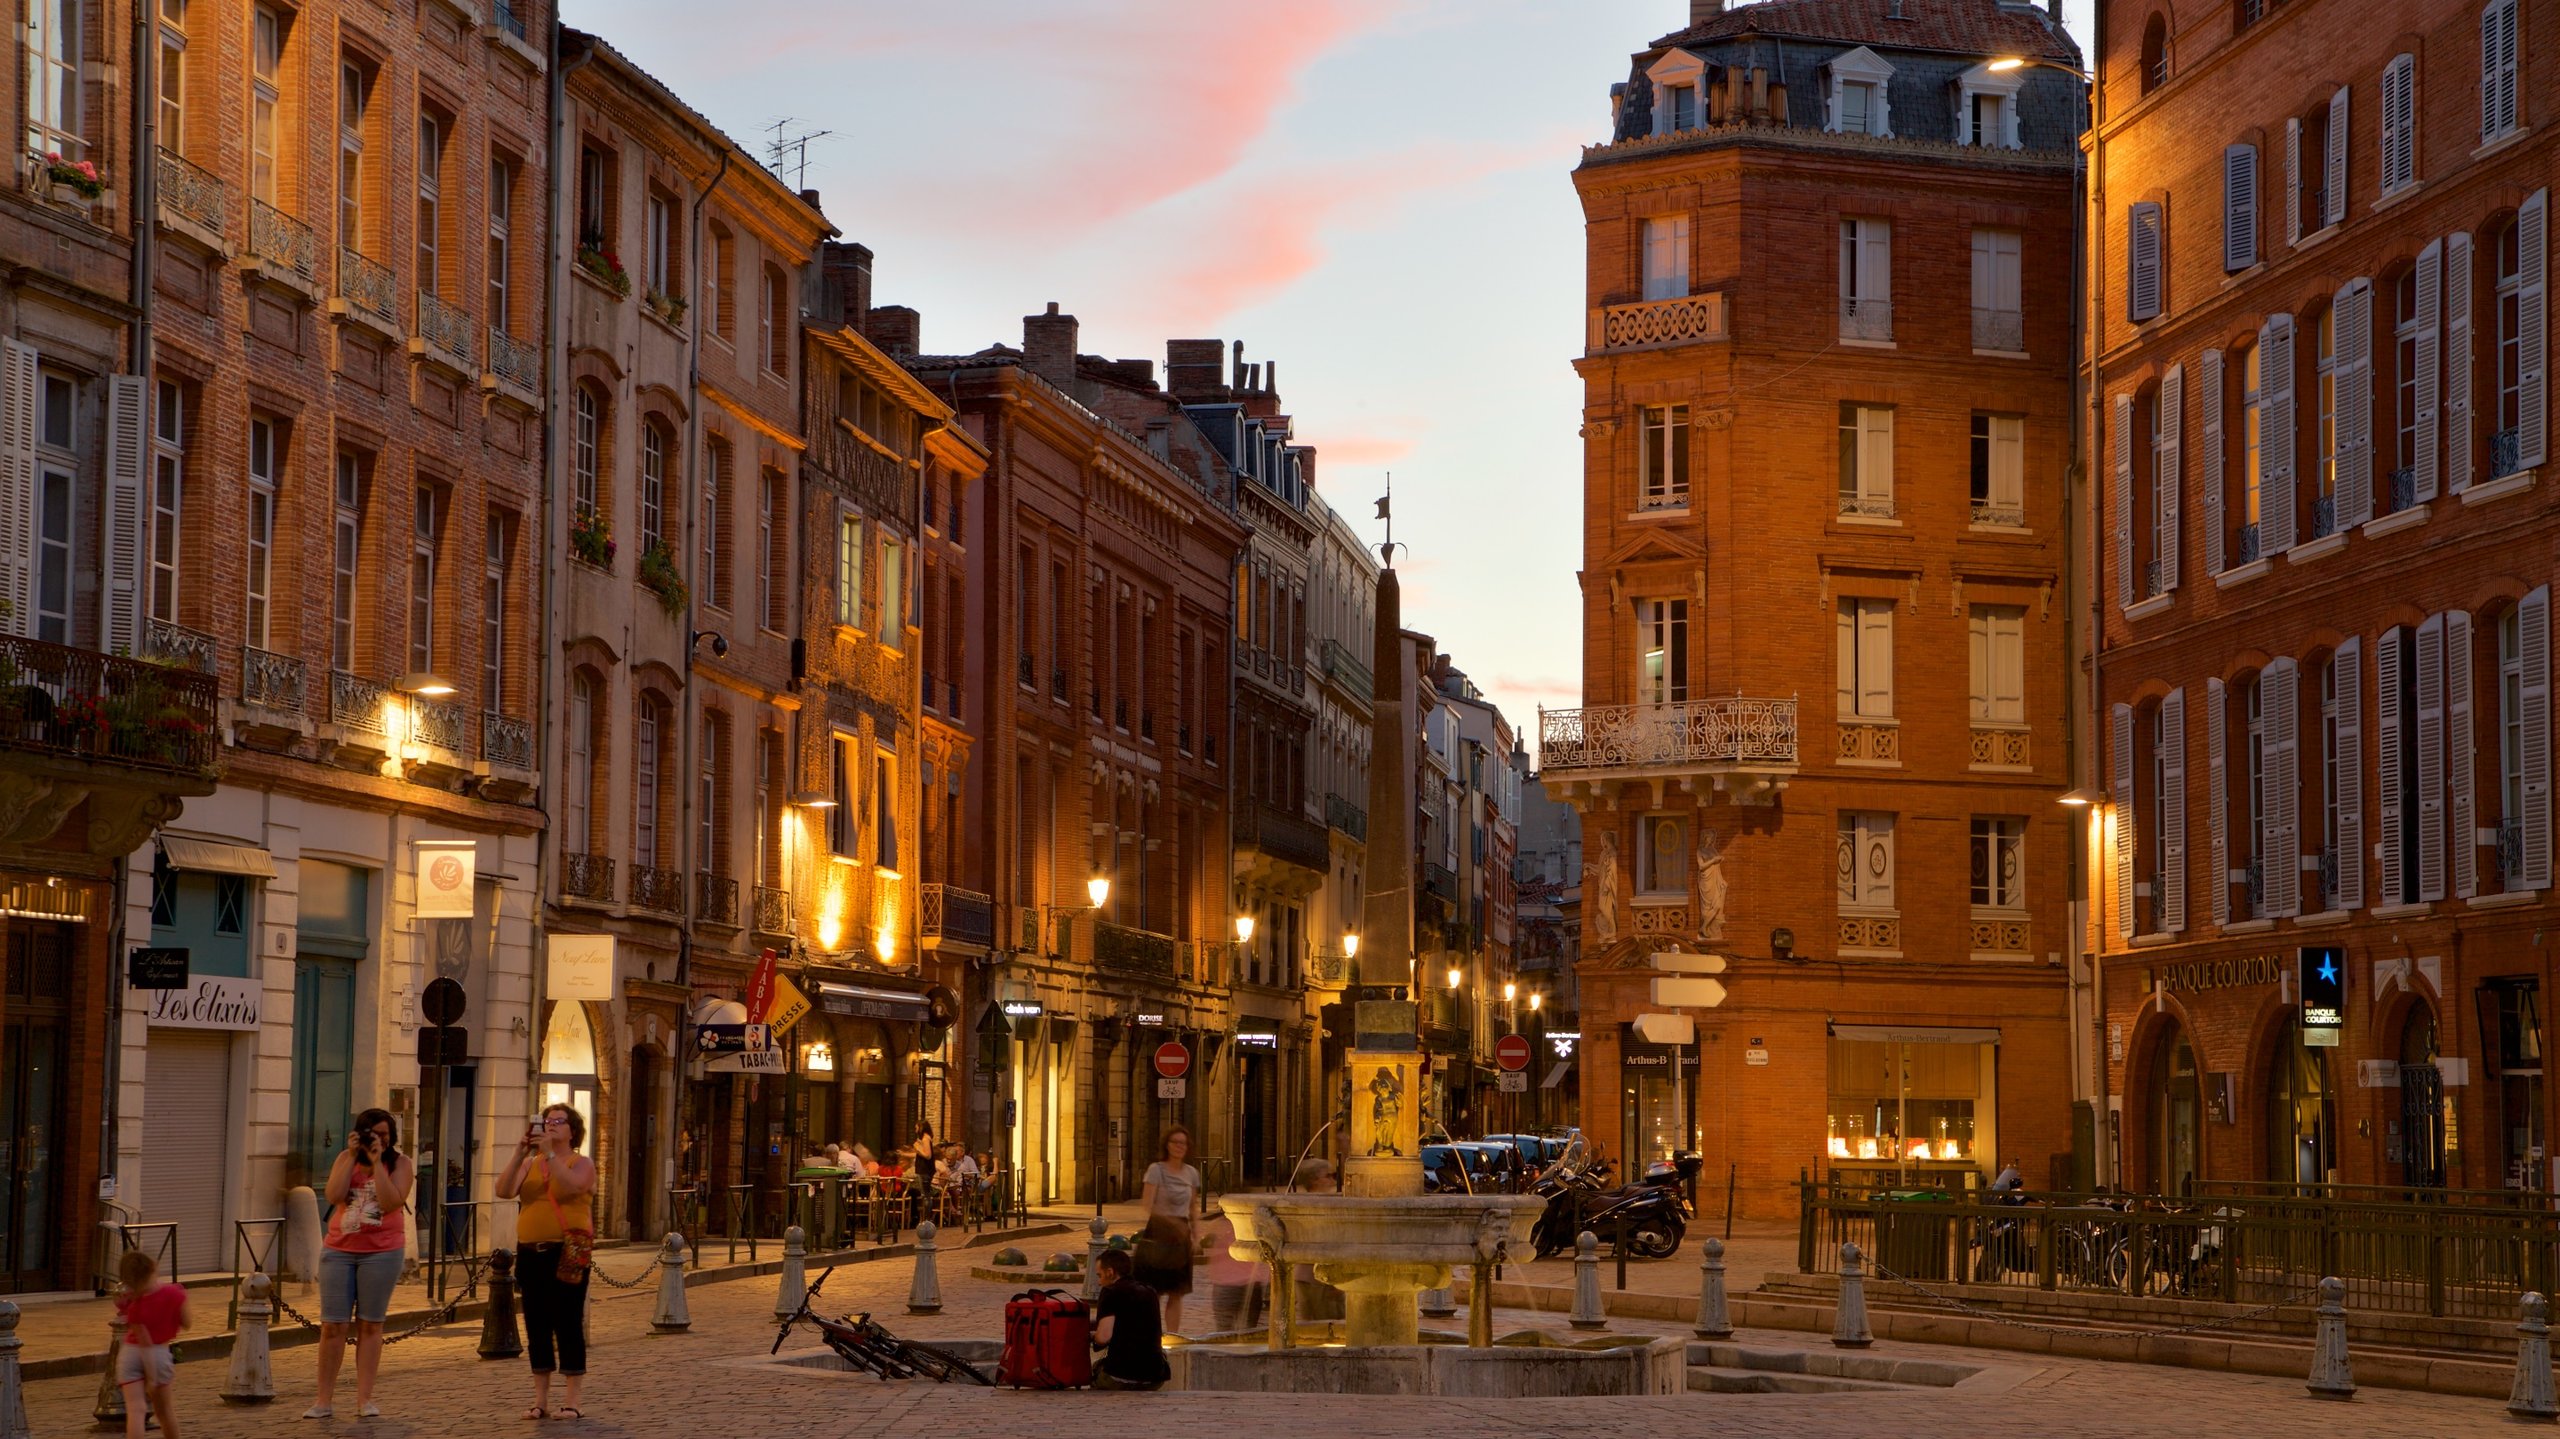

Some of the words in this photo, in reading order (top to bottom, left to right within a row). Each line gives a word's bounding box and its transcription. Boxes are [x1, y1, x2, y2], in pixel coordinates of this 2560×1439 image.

[750, 958, 772, 1024] TABAC
[2162, 963, 2212, 995] BANQUE
[2214, 955, 2280, 988] COURTOIS
[151, 988, 189, 1021] Les
[193, 981, 257, 1024] Elixirs
[771, 1001, 804, 1034] PRESSE
[2305, 1009, 2336, 1017] BANQUE
[2305, 1016, 2342, 1024] COURTOIS
[1626, 1055, 1699, 1065] Arthus-Brand
